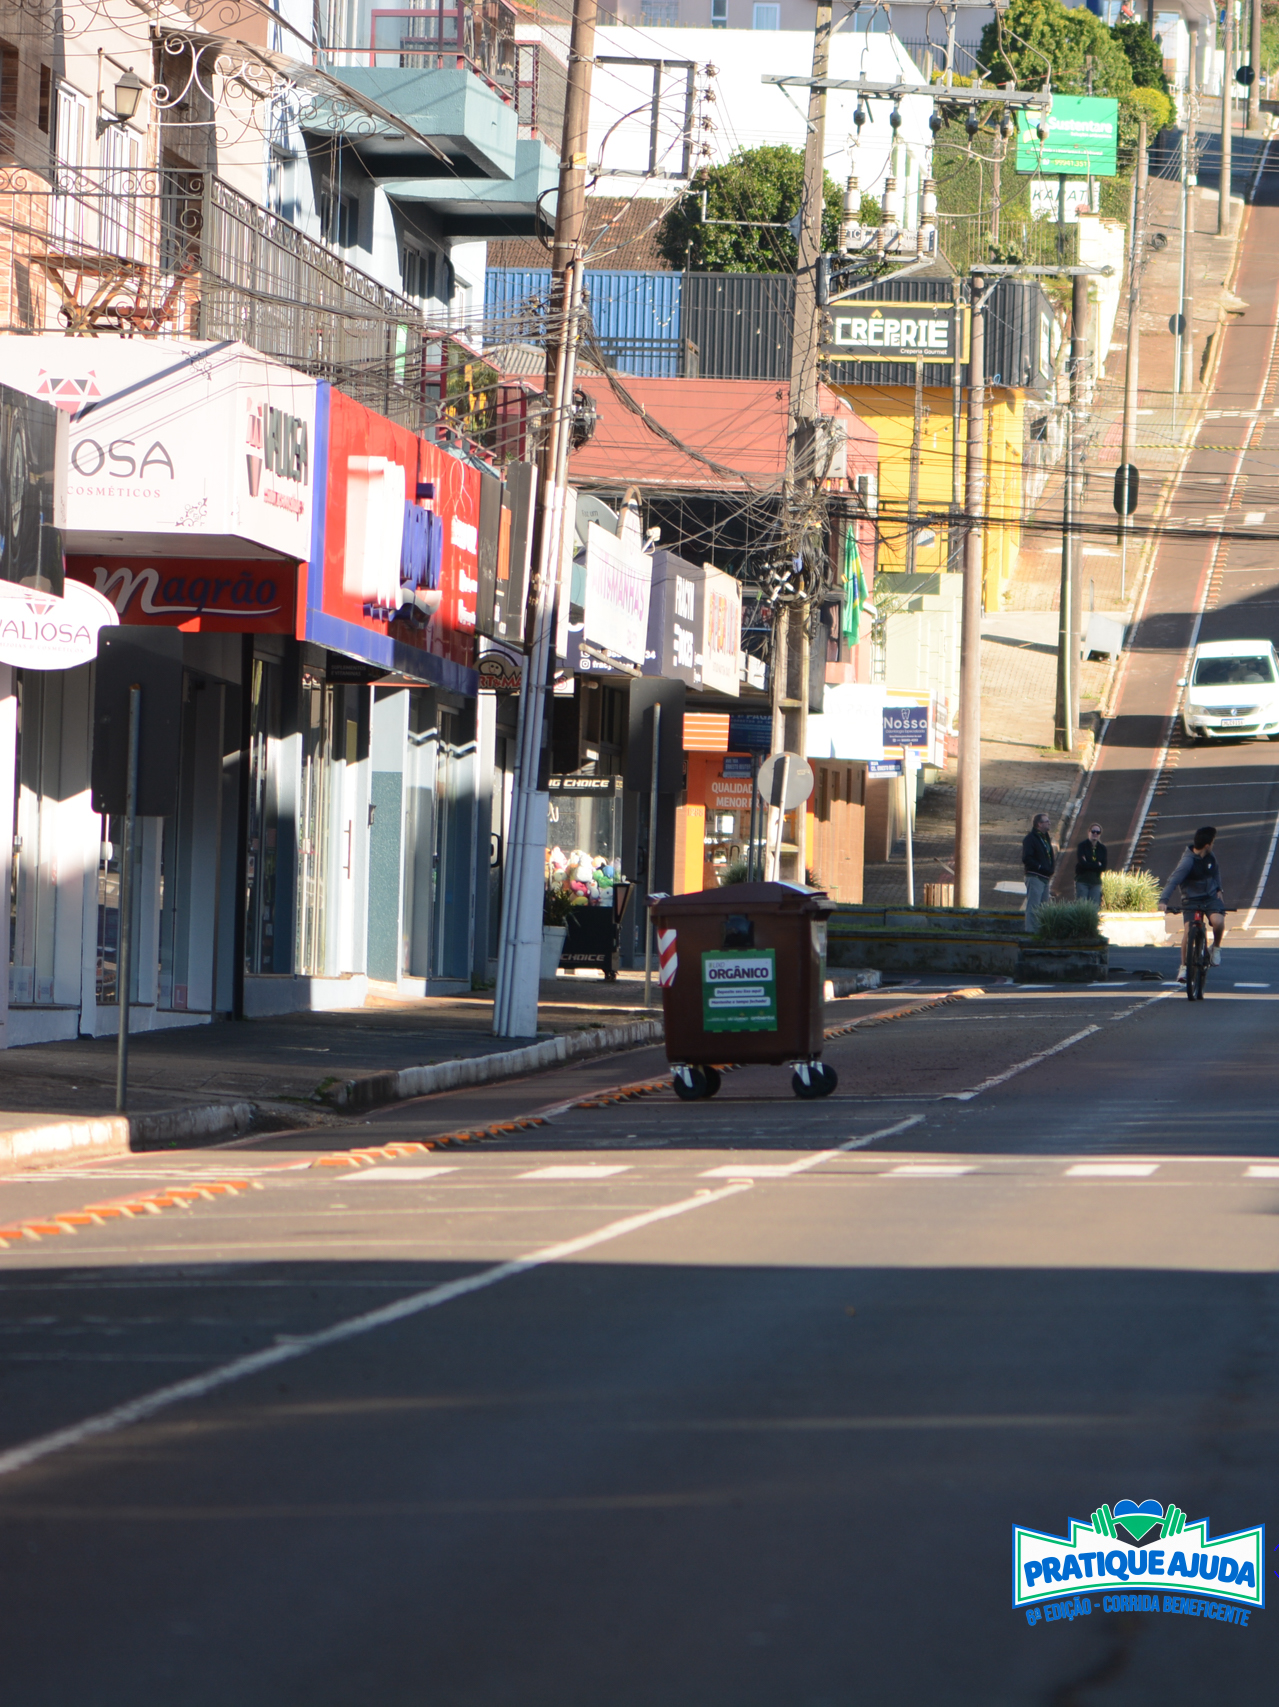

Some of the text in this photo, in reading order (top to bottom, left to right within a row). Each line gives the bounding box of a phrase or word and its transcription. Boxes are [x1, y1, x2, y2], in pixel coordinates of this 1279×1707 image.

[1048, 116, 1113, 134] Sustentare
[1032, 189, 1088, 201] KAAT
[900, 347, 923, 355] Creperia
[67, 485, 161, 498] COSMÉTICOS
[93, 567, 277, 616] Magrão
[0, 619, 91, 645] ALIOSA
[883, 717, 928, 729] Nossa
[548, 779, 610, 788] IG CHOICE
[716, 797, 747, 808] MENOR
[560, 953, 606, 962] CHOICE
[709, 965, 769, 980] ORGÂNICO
